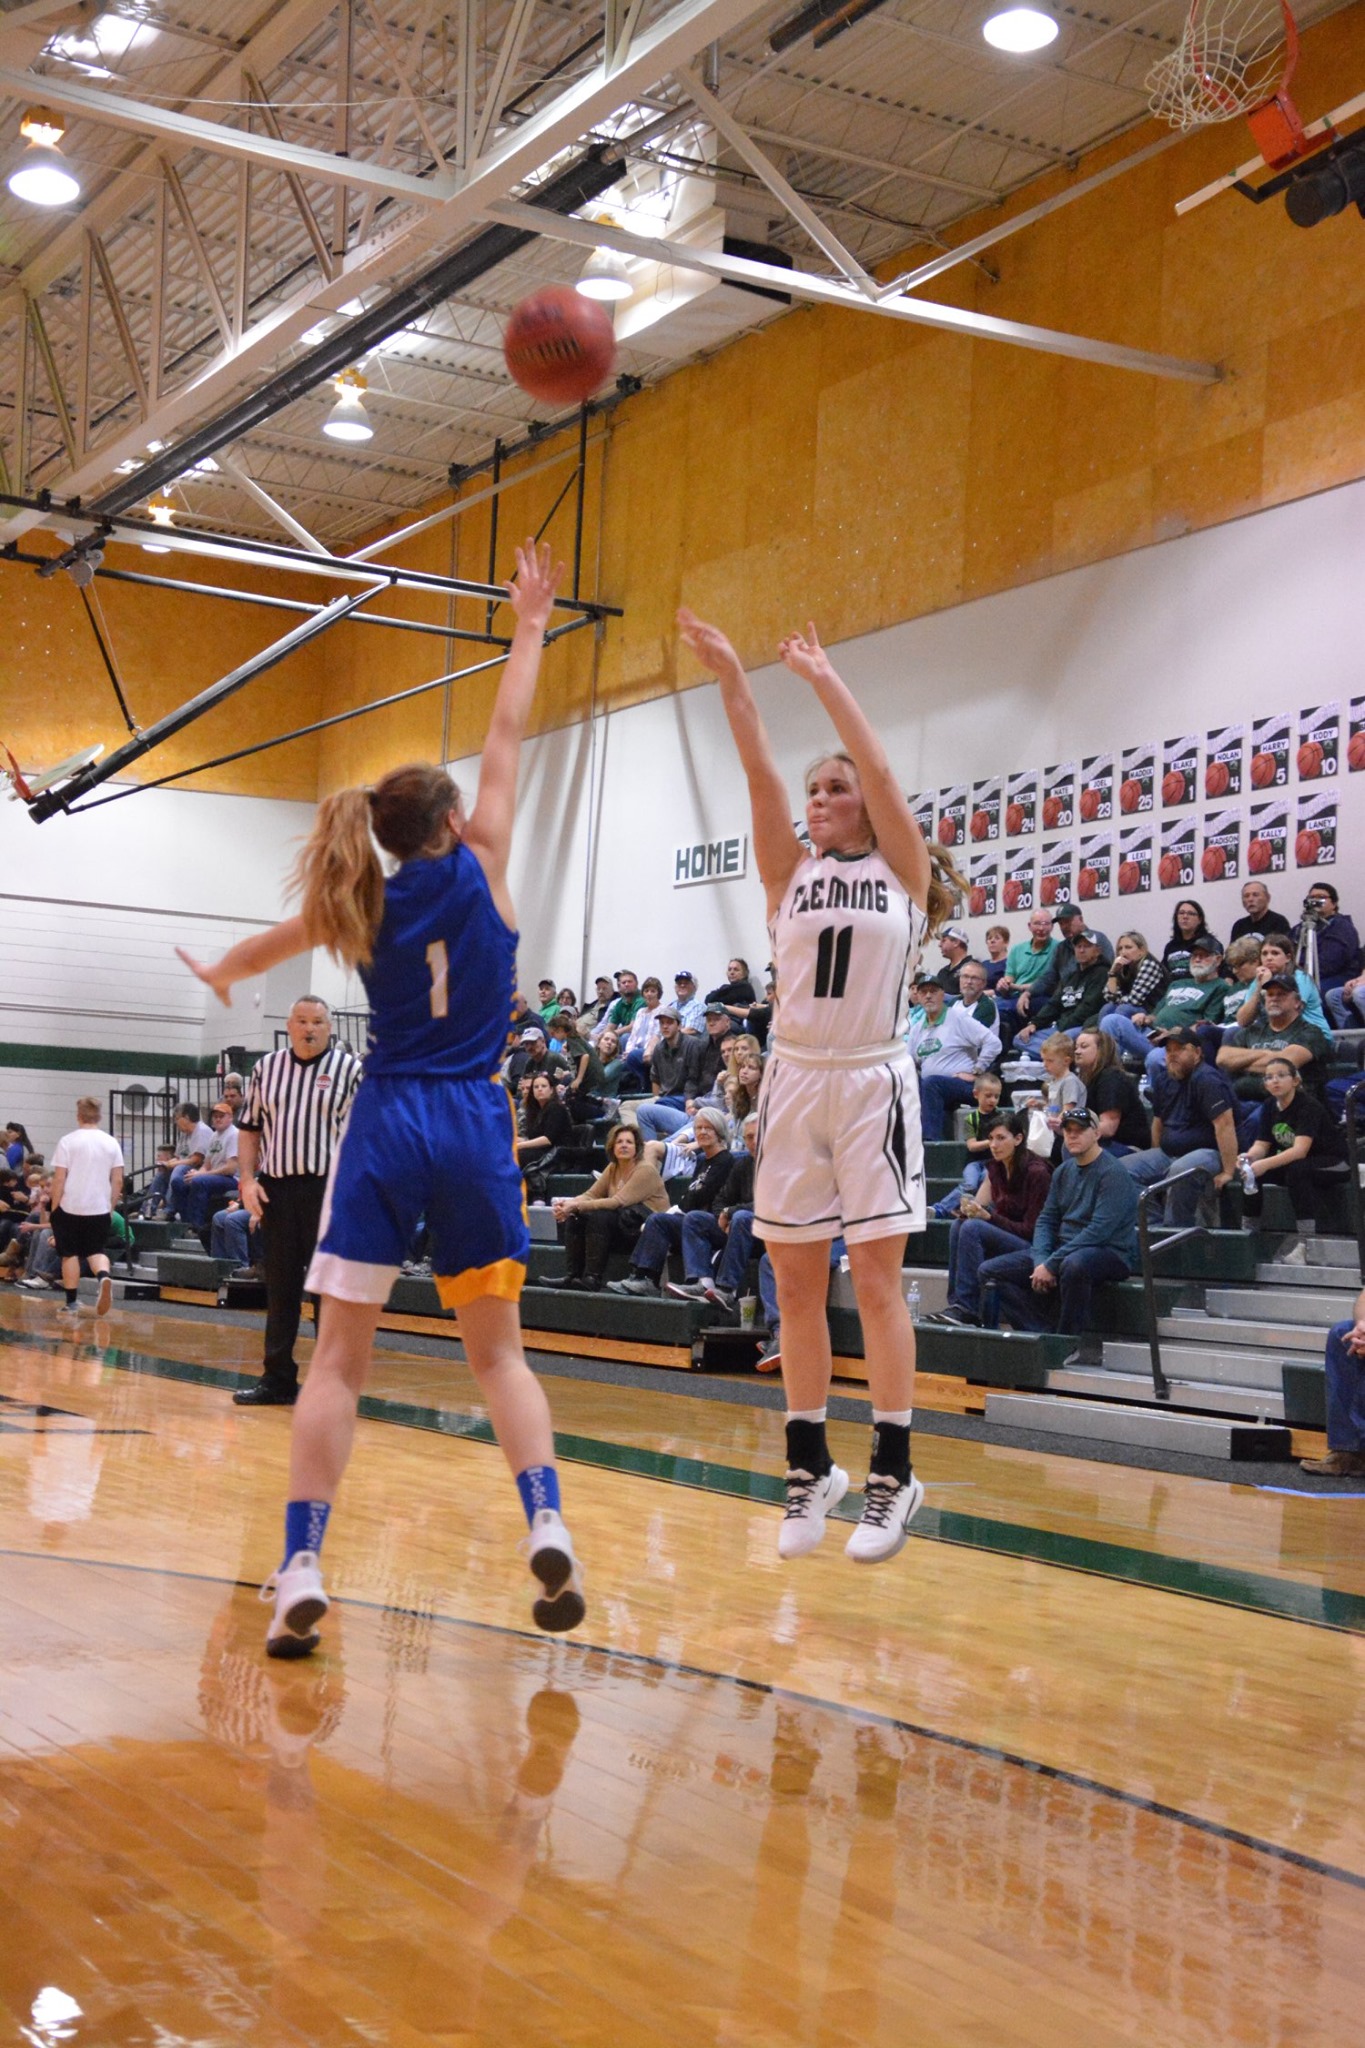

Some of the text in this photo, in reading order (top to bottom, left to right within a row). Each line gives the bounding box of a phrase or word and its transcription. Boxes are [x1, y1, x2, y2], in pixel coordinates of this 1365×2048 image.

[1312, 730, 1335, 742] KODY
[1262, 740, 1287, 753] HARRY
[1217, 750, 1241, 762] NOLAN
[1173, 759, 1194, 771] BLAKE
[1320, 756, 1337, 776] 10
[1093, 779, 1108, 789] JOEL
[1229, 775, 1240, 792] 4
[1276, 768, 1286, 785] 5
[1016, 794, 1032, 804] CHRIS
[1054, 786, 1069, 796] NATE
[1188, 785, 1194, 800] 1
[1138, 793, 1152, 810] 25
[948, 806, 963, 816] KADE
[1057, 809, 1073, 826] 20
[1097, 801, 1112, 819] 23
[987, 823, 998, 839] 15
[1021, 817, 1034, 833] 24
[1308, 818, 1333, 830] LANEY
[956, 828, 964, 844] 3
[1209, 834, 1240, 846] MADISON
[1260, 828, 1283, 840] KALLY
[676, 838, 740, 880] HOME
[1131, 851, 1146, 861] LEXI
[1271, 853, 1285, 871] 14
[1316, 845, 1335, 864] 22
[1015, 871, 1030, 880] ZOEY
[1041, 864, 1072, 876] SAMANTHA
[1179, 867, 1194, 884] 10
[1224, 860, 1237, 877] 12
[1095, 881, 1110, 898] 42
[1141, 874, 1150, 890] 4
[789, 875, 889, 919] FLEMING
[1017, 892, 1032, 909] 20
[1055, 886, 1071, 903] 30
[985, 898, 995, 914] 13
[813, 924, 854, 999] 11
[425, 938, 449, 1019] 1
